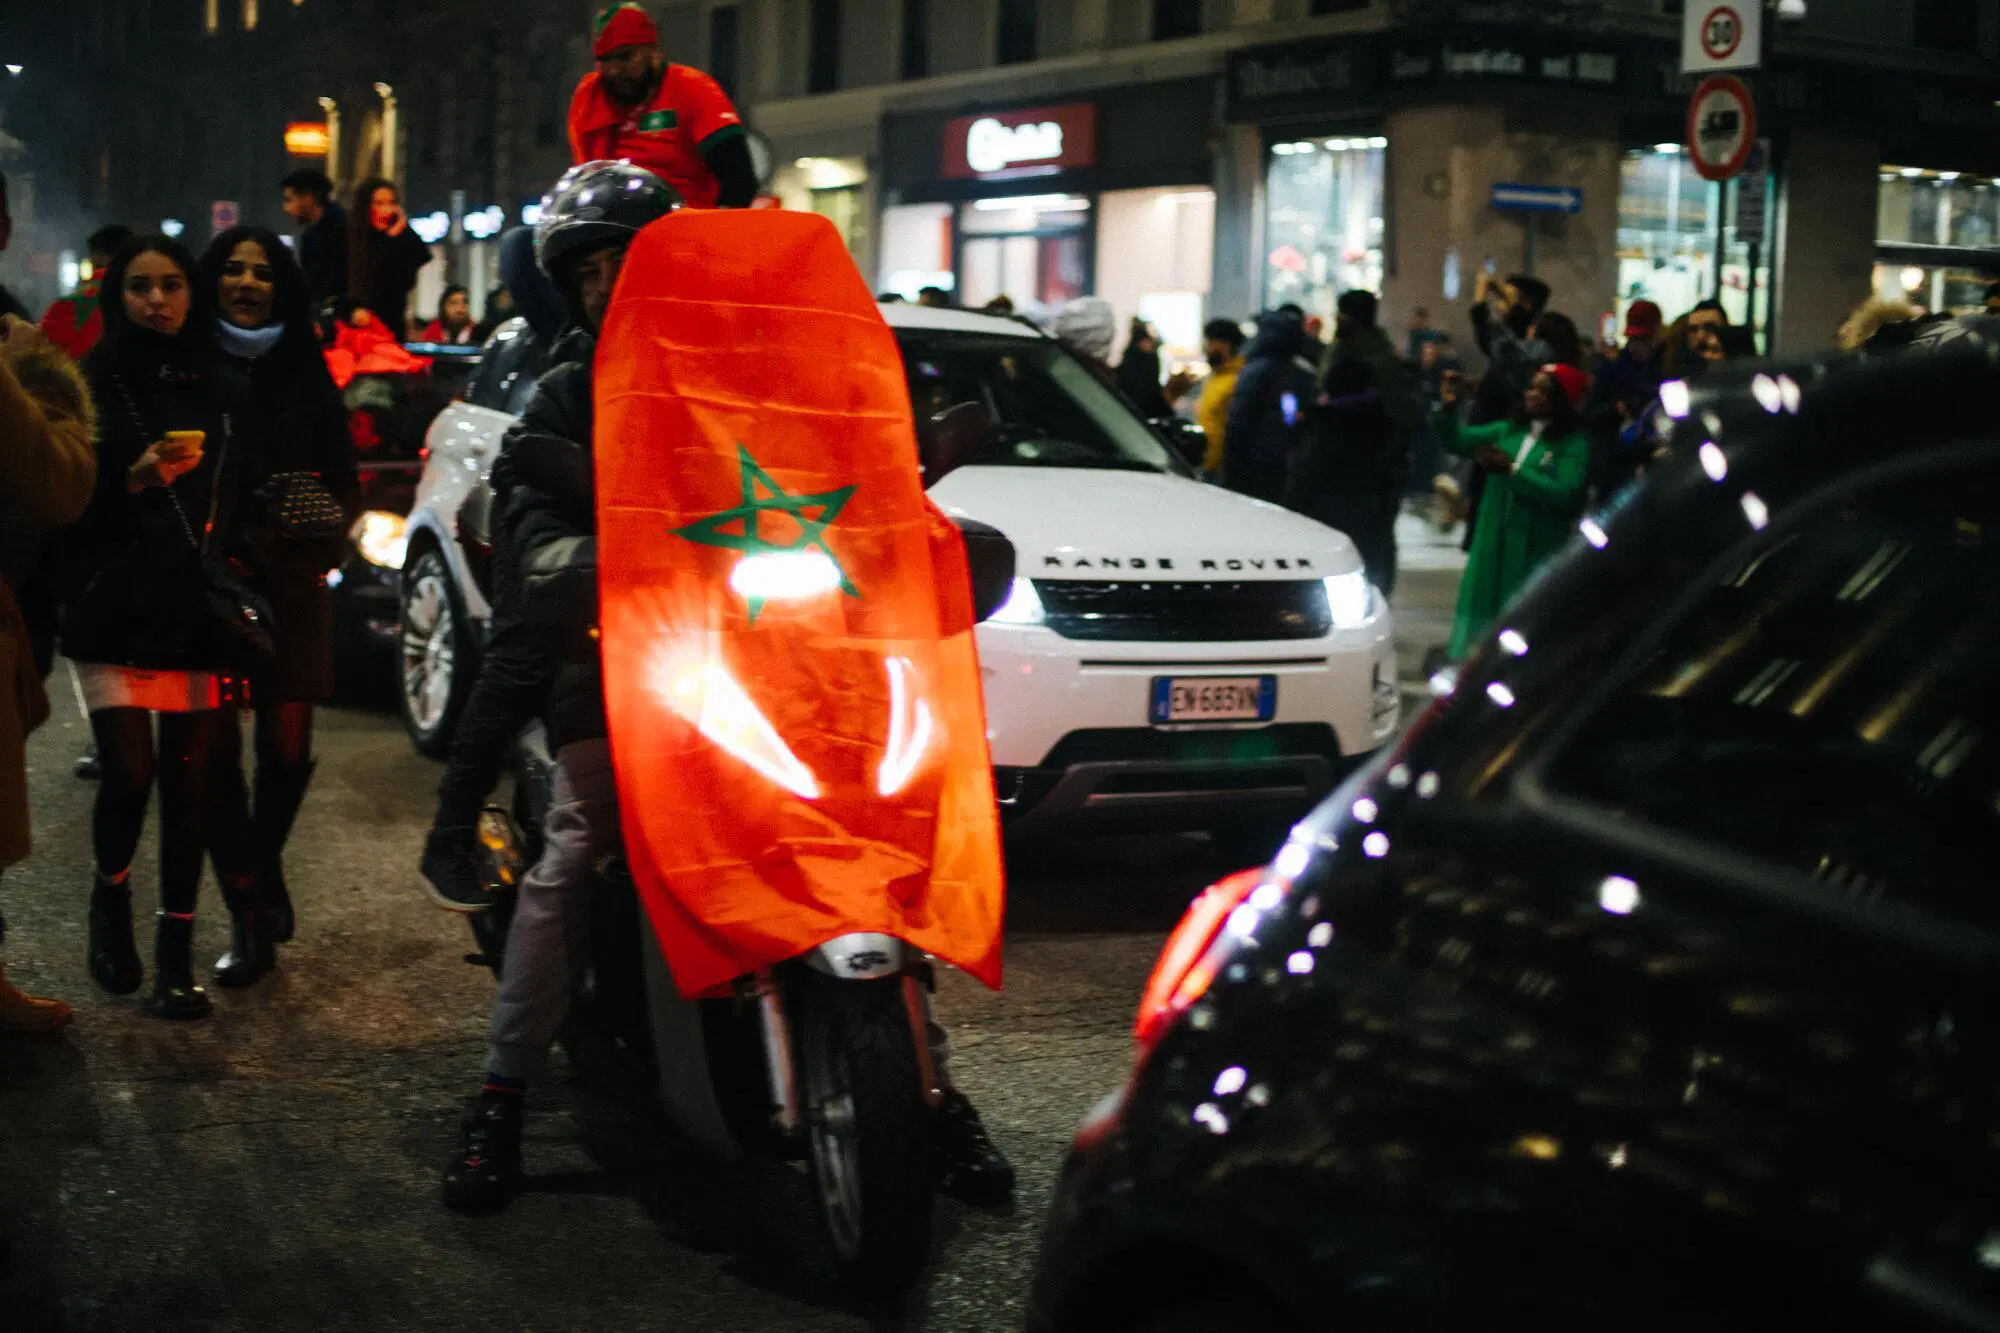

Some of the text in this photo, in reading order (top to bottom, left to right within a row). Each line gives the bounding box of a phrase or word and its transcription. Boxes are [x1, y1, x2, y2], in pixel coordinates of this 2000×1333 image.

[1709, 20, 1732, 46] 30
[1043, 555, 1313, 571] RANGE ROVER
